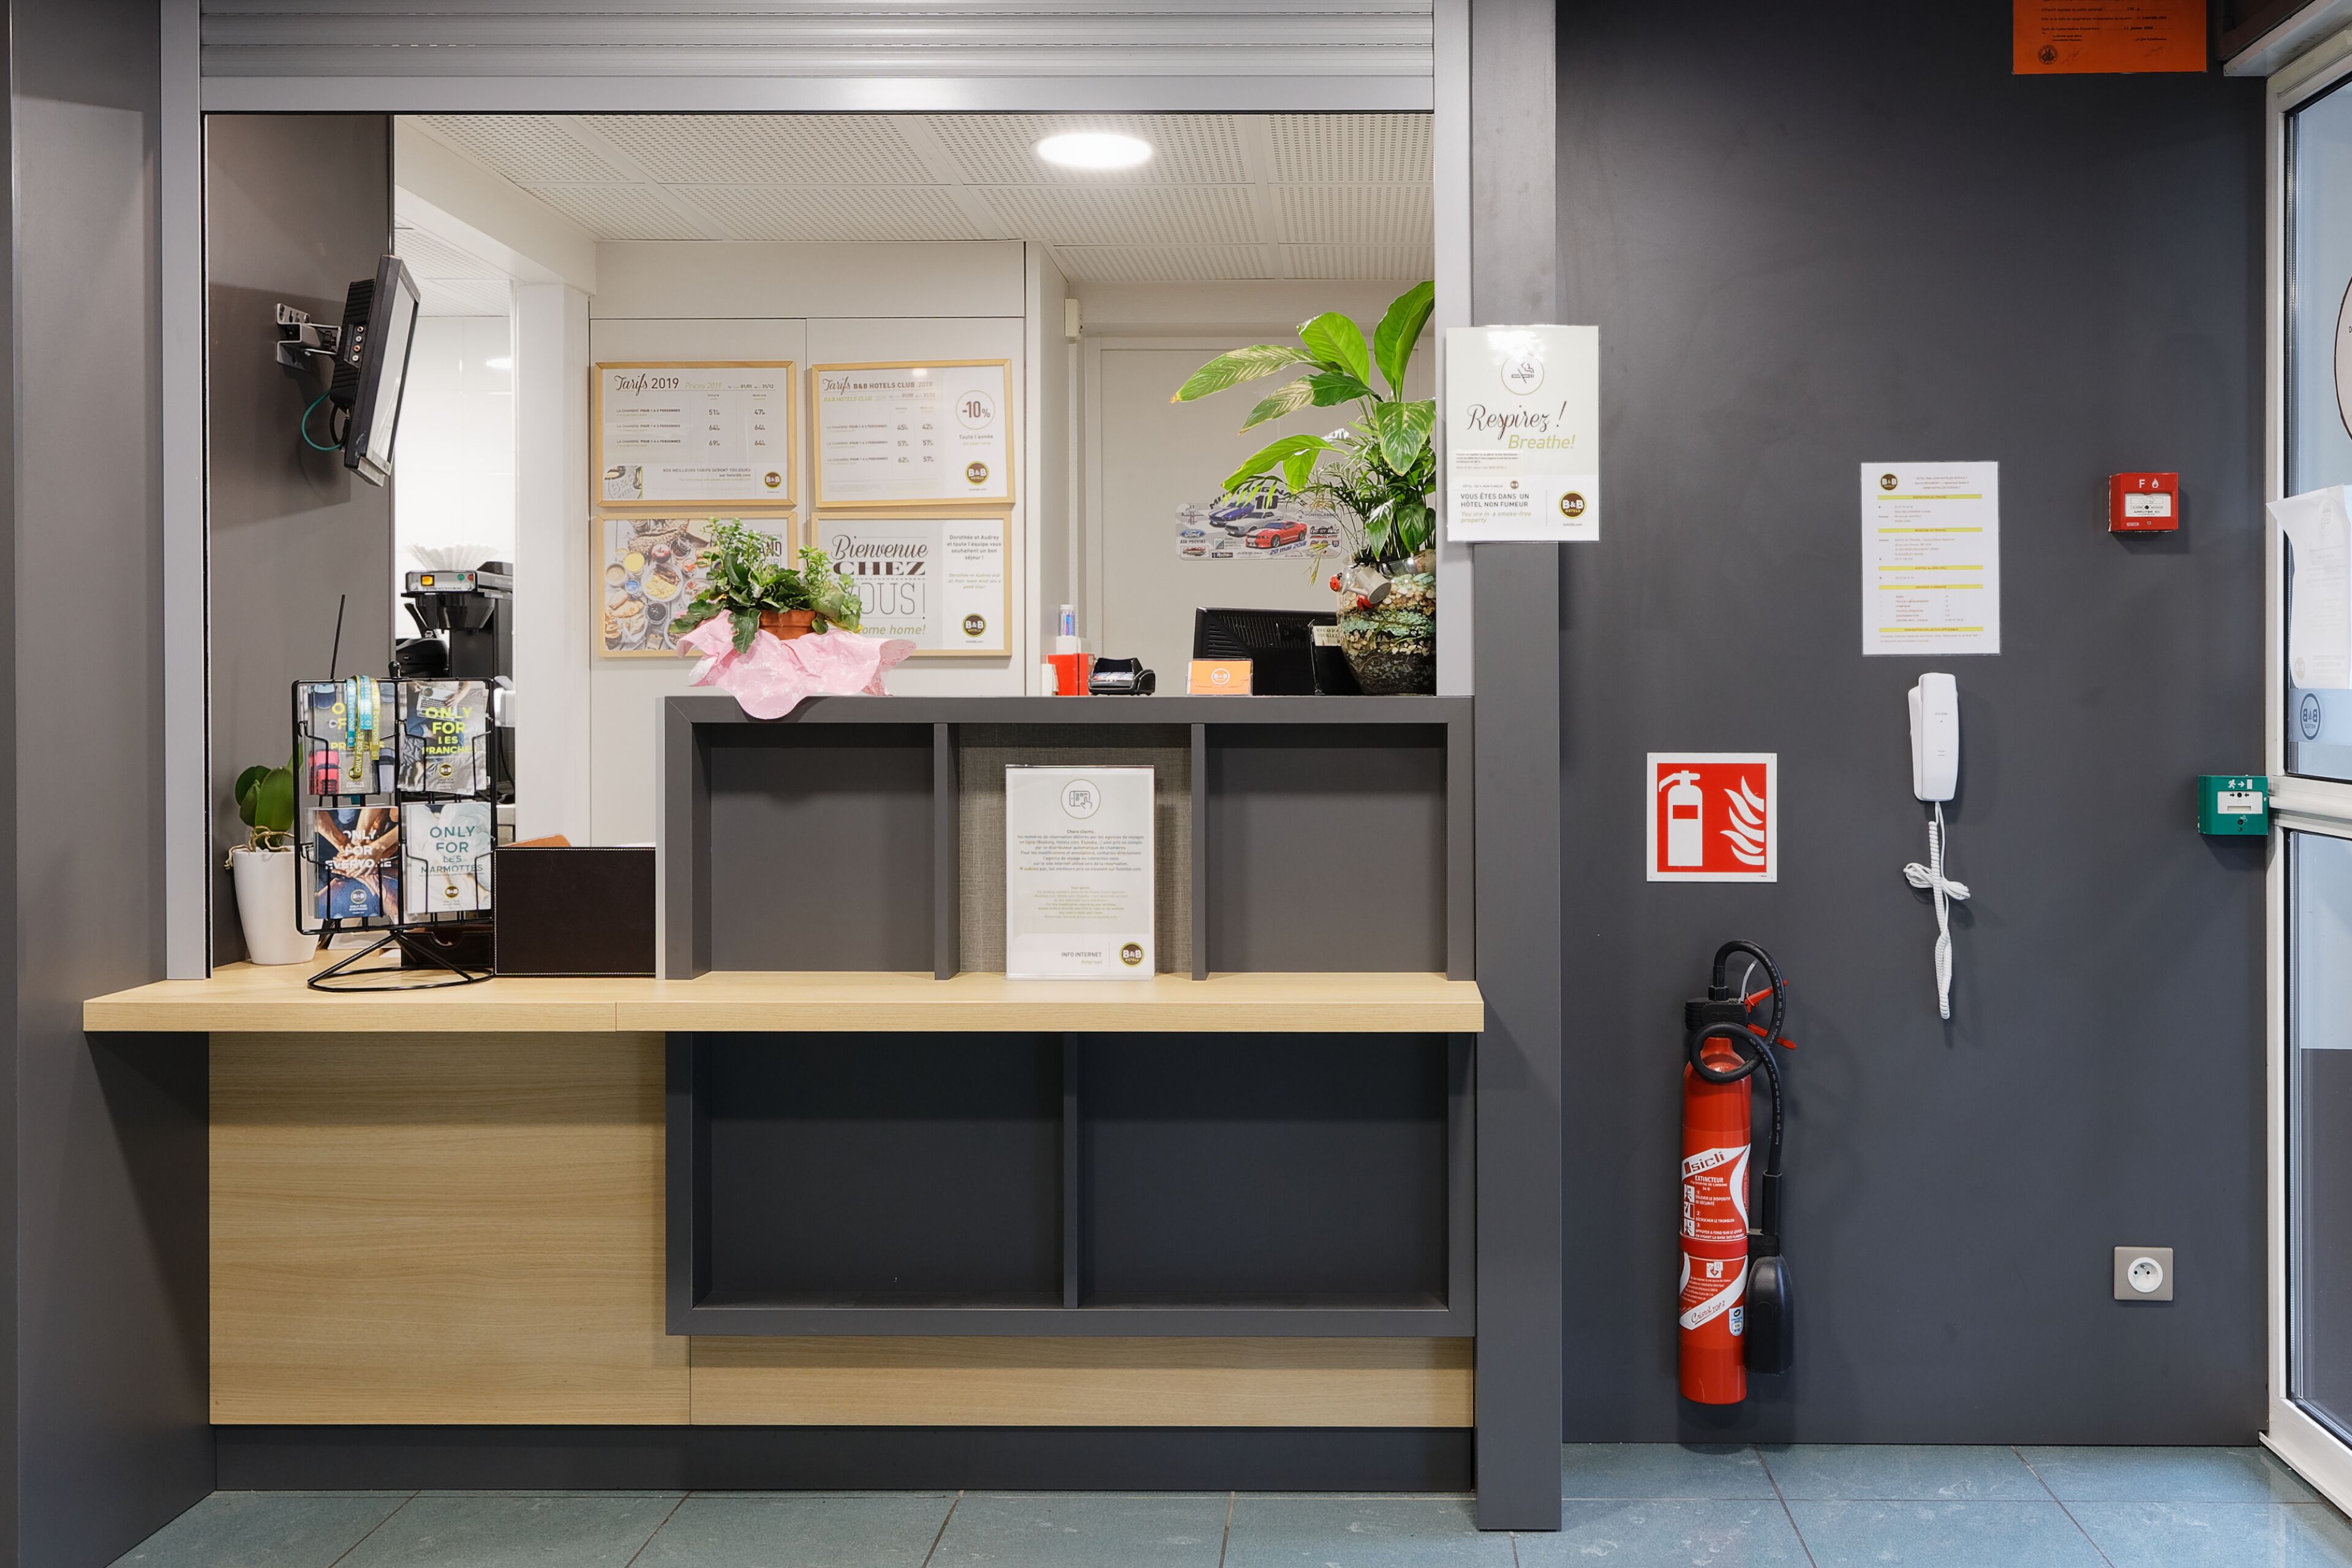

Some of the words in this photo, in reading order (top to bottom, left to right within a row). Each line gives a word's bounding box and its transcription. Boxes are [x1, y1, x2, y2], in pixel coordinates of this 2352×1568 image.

[614, 373, 647, 396] Tarifs
[651, 378, 679, 389] 2019
[822, 376, 851, 395] Tarifs
[1466, 404, 1550, 440] Respirez
[1509, 434, 1576, 450] Breathe!
[968, 468, 987, 477] B&B
[2139, 479, 2145, 488] F
[1562, 500, 1584, 509] B&B
[831, 534, 929, 560] Bienvenue
[1293, 541, 1307, 549] 2018
[833, 562, 925, 575] CHEZ
[850, 582, 925, 619] OUS!
[890, 624, 926, 635] home!
[965, 620, 984, 629] B&B
[426, 706, 472, 718] ONLY
[432, 722, 466, 734] FOR
[342, 830, 377, 840] ONLY
[430, 826, 475, 838] ONLY
[345, 845, 374, 856] FOR
[436, 842, 469, 853] FOR
[421, 864, 483, 873] MARMOTTES
[1691, 1152, 1725, 1172] sicli
[1691, 1306, 1711, 1323] Cristal
[1713, 1303, 1722, 1313] TOP
